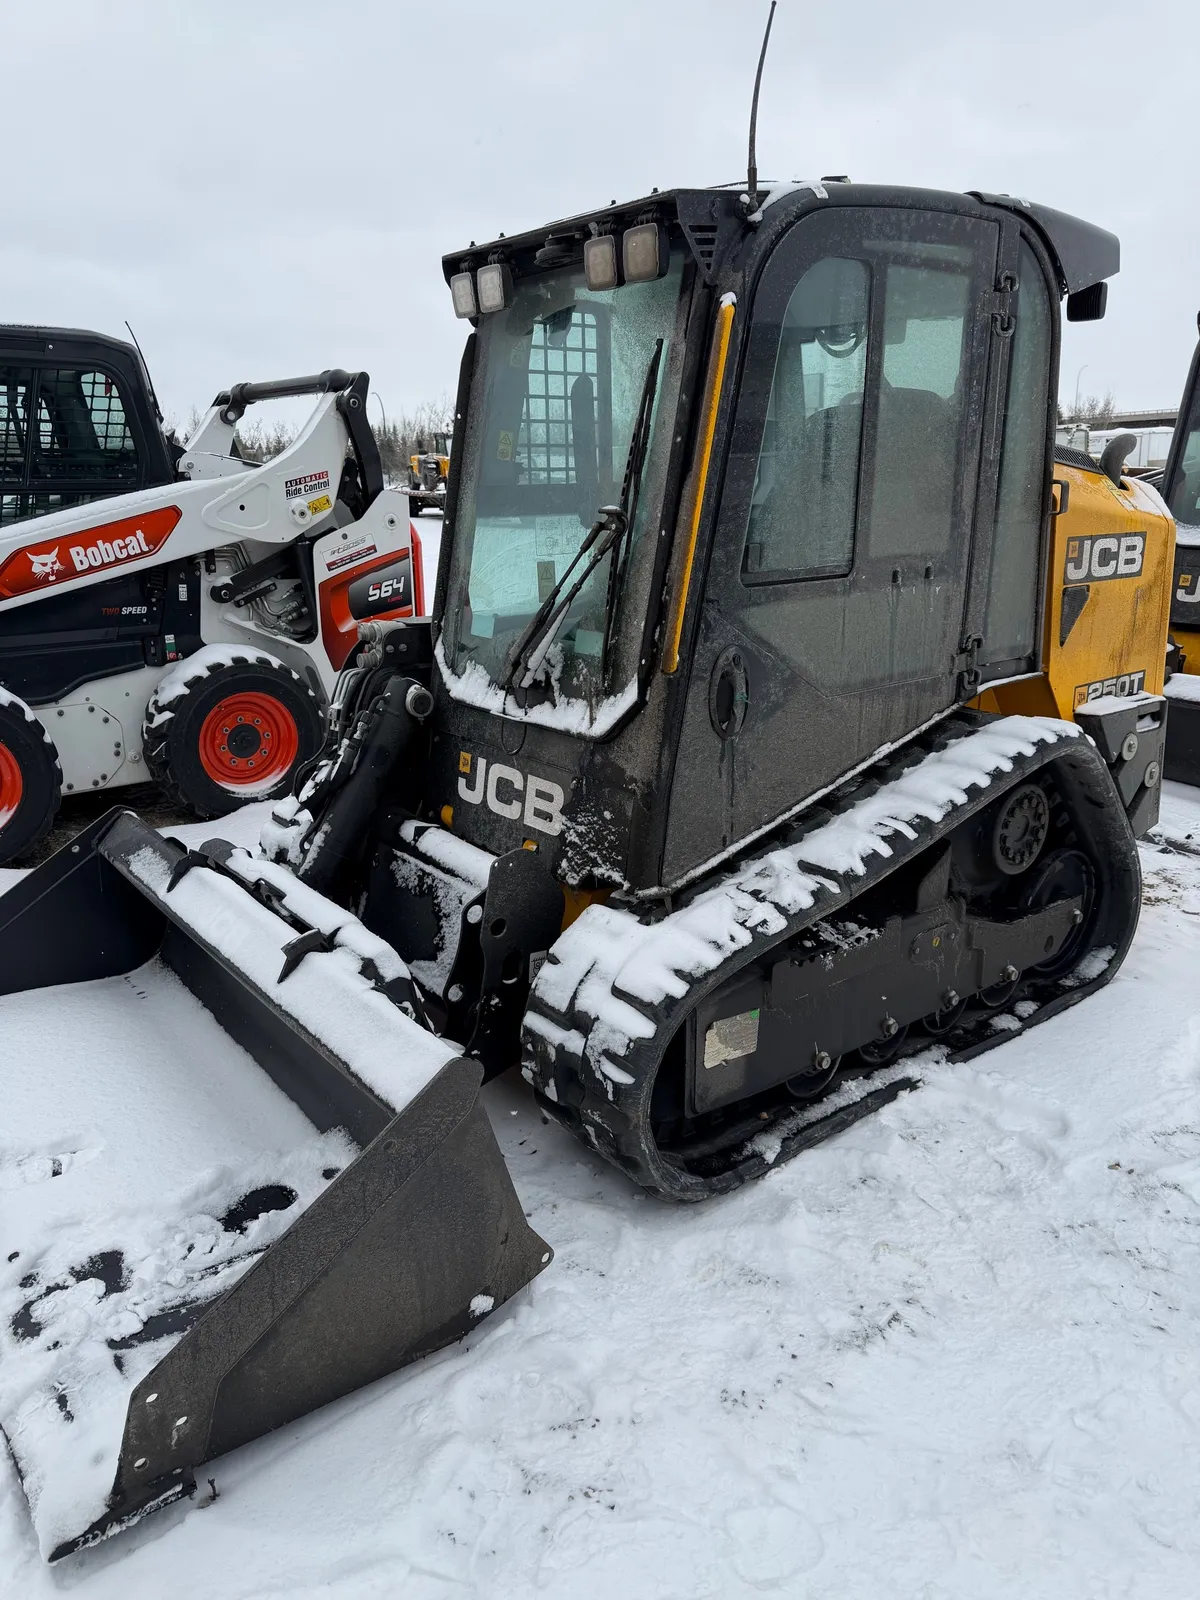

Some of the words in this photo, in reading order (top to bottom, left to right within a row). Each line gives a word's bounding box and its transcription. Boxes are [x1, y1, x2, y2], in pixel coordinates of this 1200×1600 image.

[286, 471, 328, 488] AUTOMATIC
[286, 486, 303, 498] Ride
[304, 479, 330, 493] Control
[69, 529, 149, 572] Bobcat
[1066, 536, 1144, 580] JCB
[368, 576, 405, 601] S64
[101, 607, 120, 616] TWO
[121, 606, 148, 615] SPEED
[1088, 671, 1144, 702] 250T
[457, 756, 565, 837] JCB
